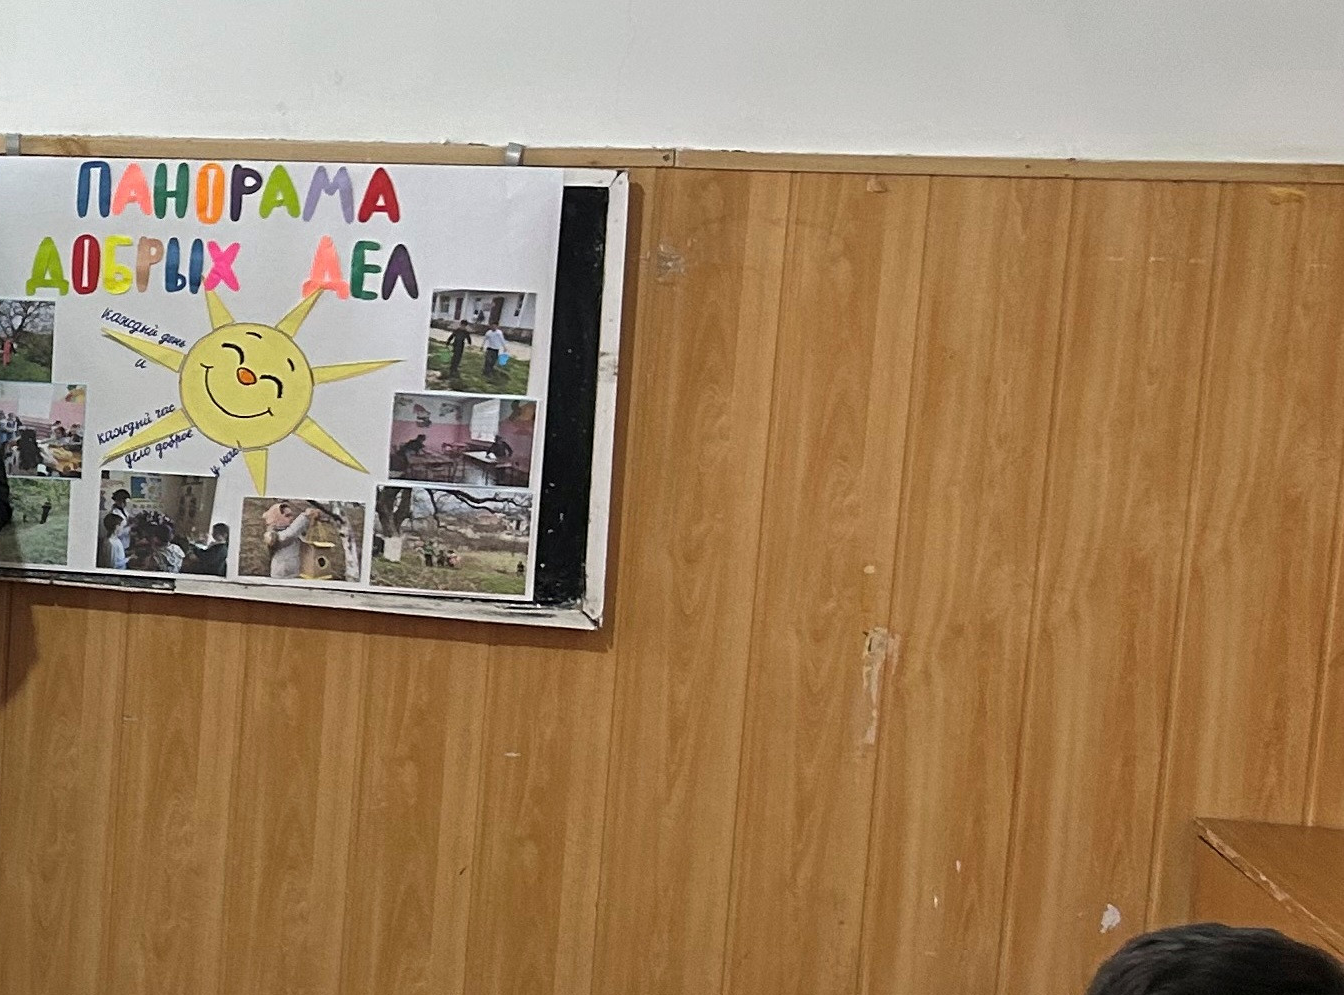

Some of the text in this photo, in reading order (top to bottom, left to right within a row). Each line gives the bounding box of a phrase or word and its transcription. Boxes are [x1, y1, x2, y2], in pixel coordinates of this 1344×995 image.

[76, 160, 401, 225] ПАНОРАМА
[25, 233, 420, 301] ДОБРЫХ ДЕЛ
[158, 332, 186, 349] день
[155, 403, 176, 419] час
[124, 447, 151, 469] дело
